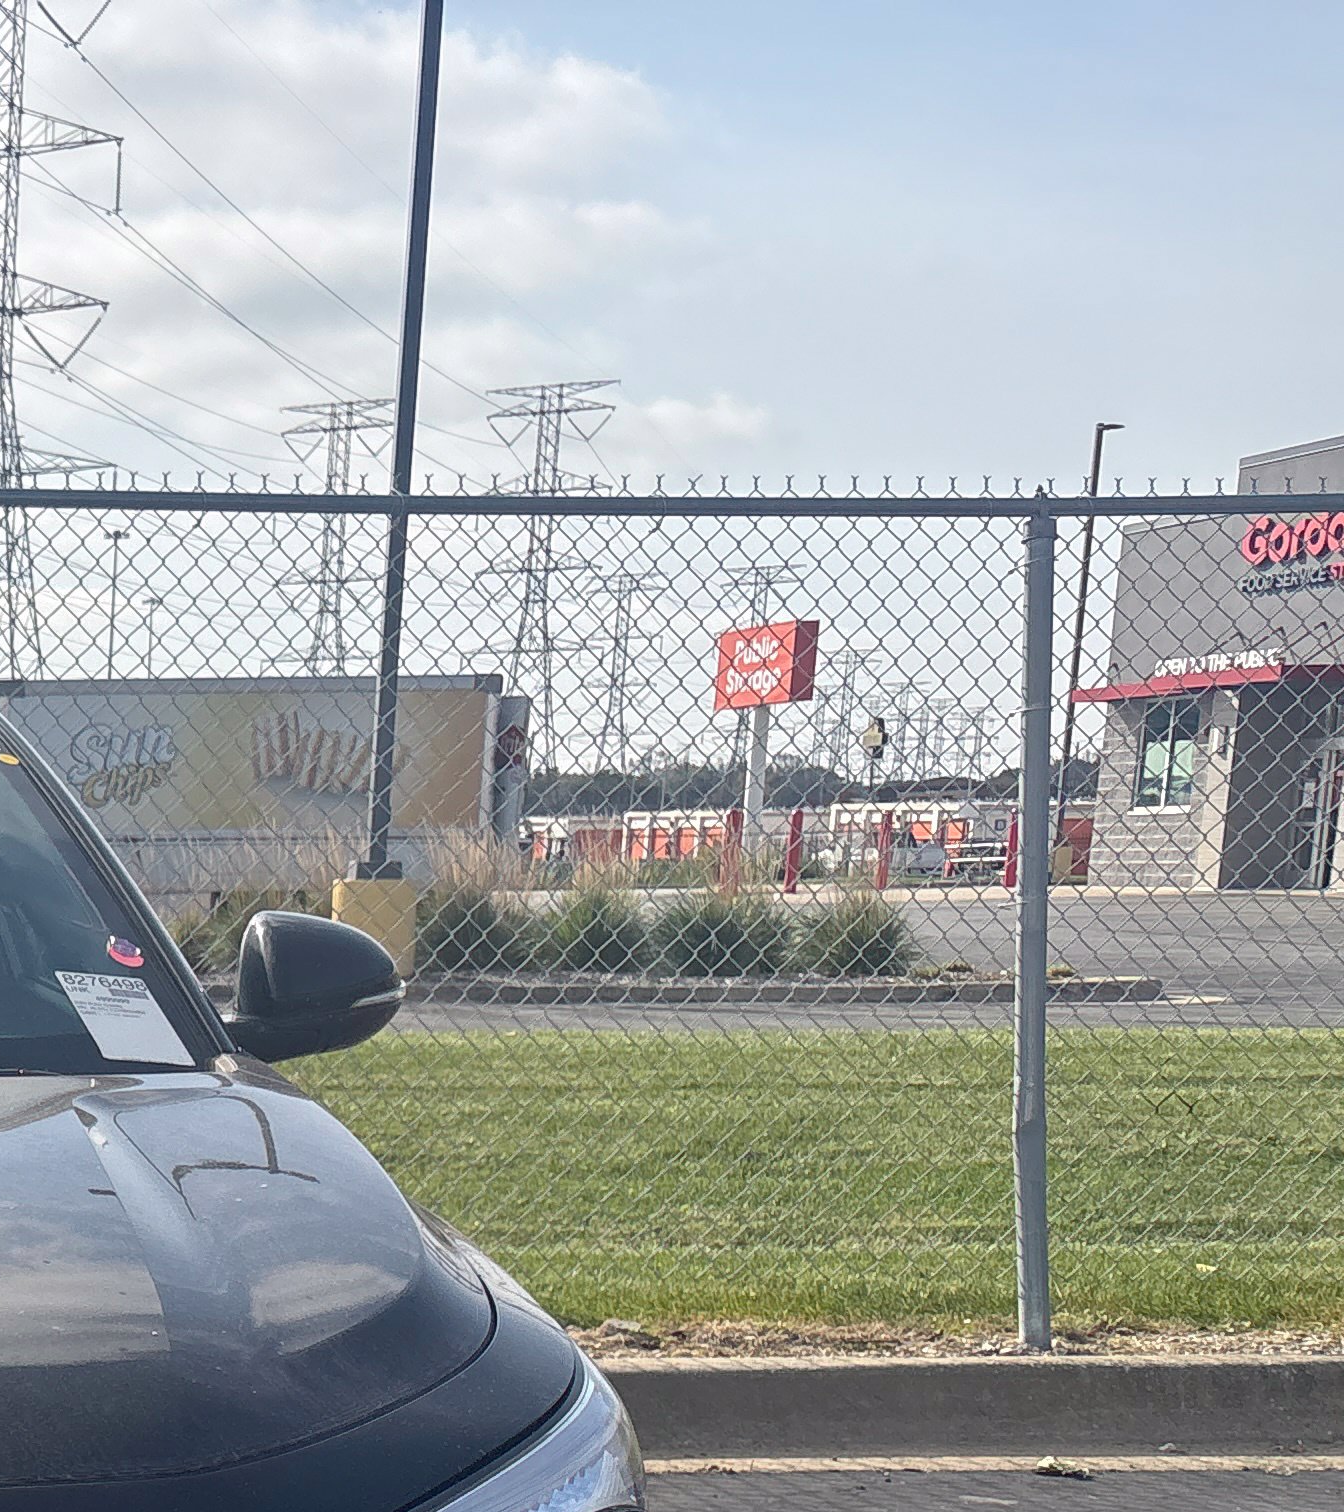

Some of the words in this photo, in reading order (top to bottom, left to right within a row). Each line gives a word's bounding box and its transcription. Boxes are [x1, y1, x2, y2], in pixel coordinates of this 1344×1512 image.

[734, 635, 779, 665] Public
[1154, 658, 1187, 677] OPEN
[1207, 653, 1232, 672] THE
[1233, 648, 1282, 669] PUBLIC
[725, 666, 782, 696] Storage
[61, 973, 148, 992] 8276498
